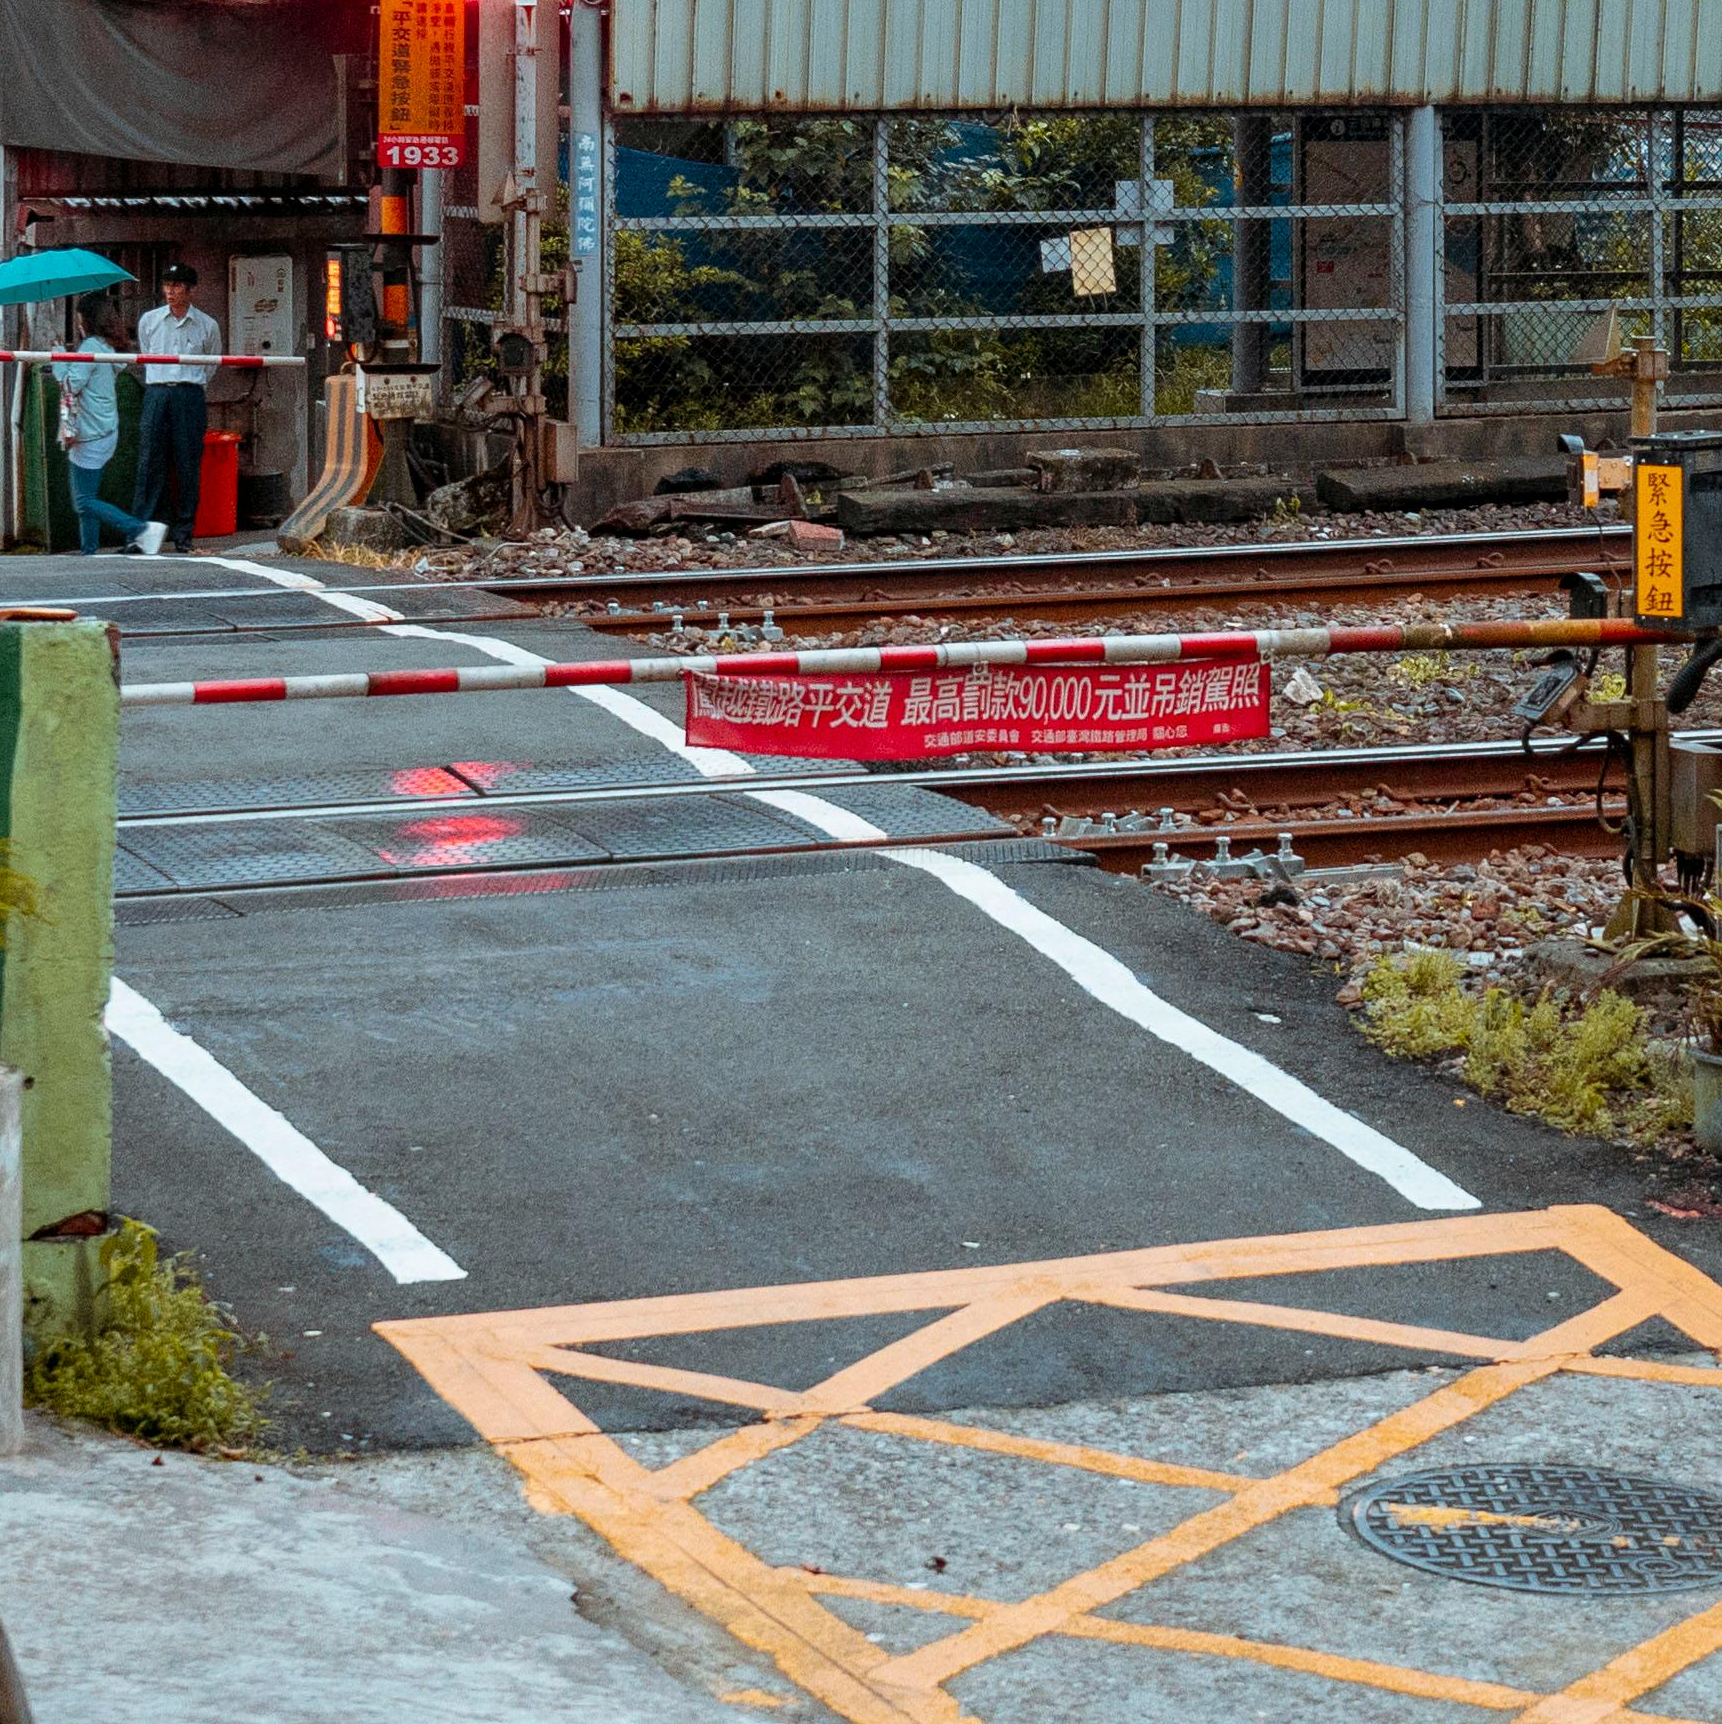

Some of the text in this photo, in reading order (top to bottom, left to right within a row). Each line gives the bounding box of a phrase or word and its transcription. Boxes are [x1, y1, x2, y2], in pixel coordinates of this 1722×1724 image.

[386, 145, 459, 165] 1933
[577, 134, 596, 252] 南無阿彌陀佛
[1644, 472, 1674, 612] 緊急按鈕
